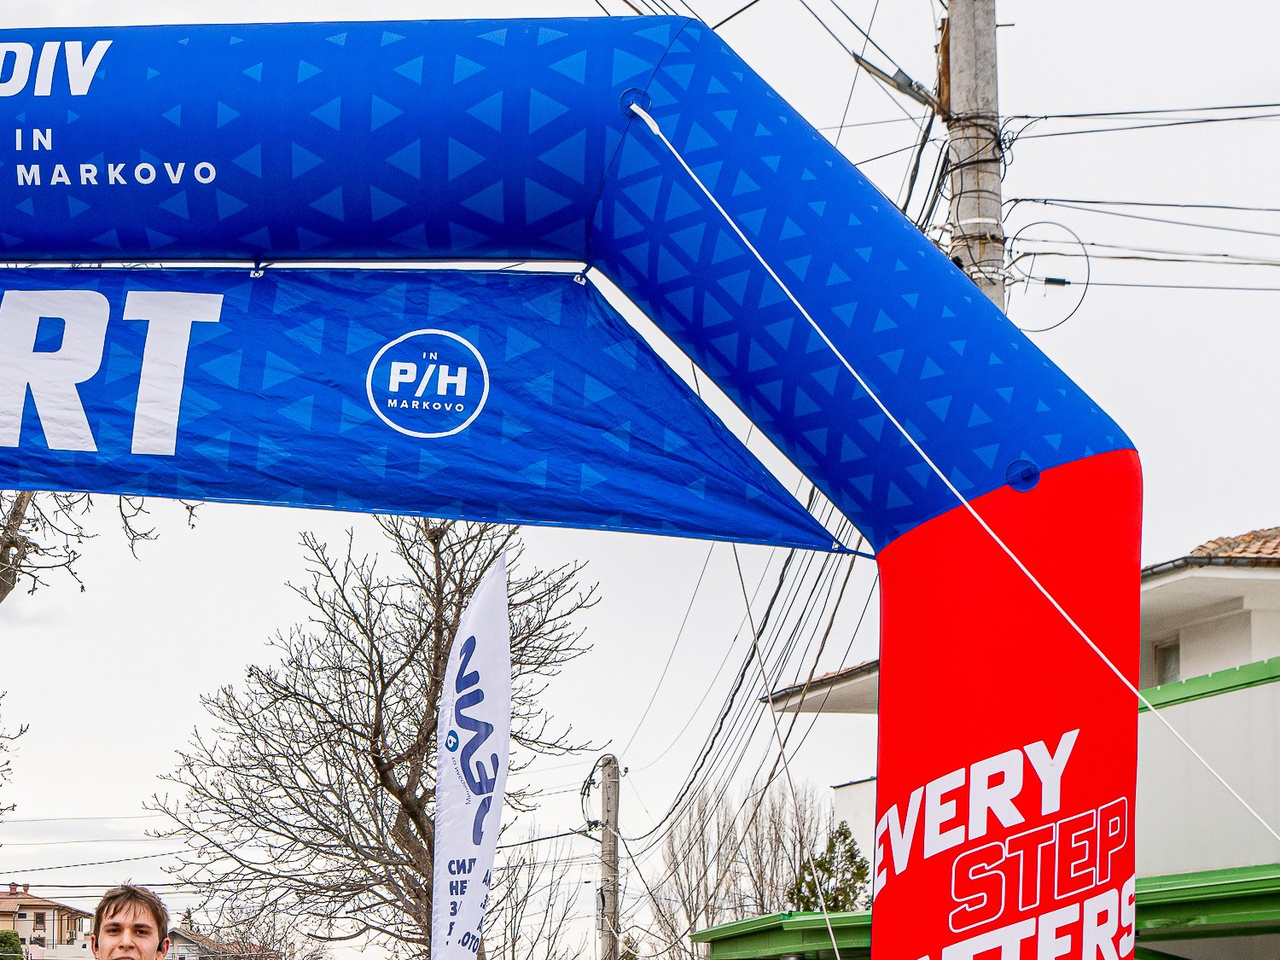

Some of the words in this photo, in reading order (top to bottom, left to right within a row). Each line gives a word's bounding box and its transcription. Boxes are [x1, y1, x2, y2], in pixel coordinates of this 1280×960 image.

[15, 128, 53, 151] IN
[16, 161, 218, 186] MARKOVO
[422, 351, 439, 361] IN
[388, 361, 468, 397] P/H
[387, 398, 465, 412] MARKOVO
[873, 728, 1080, 903] EVERY
[948, 796, 1128, 934] STEP
